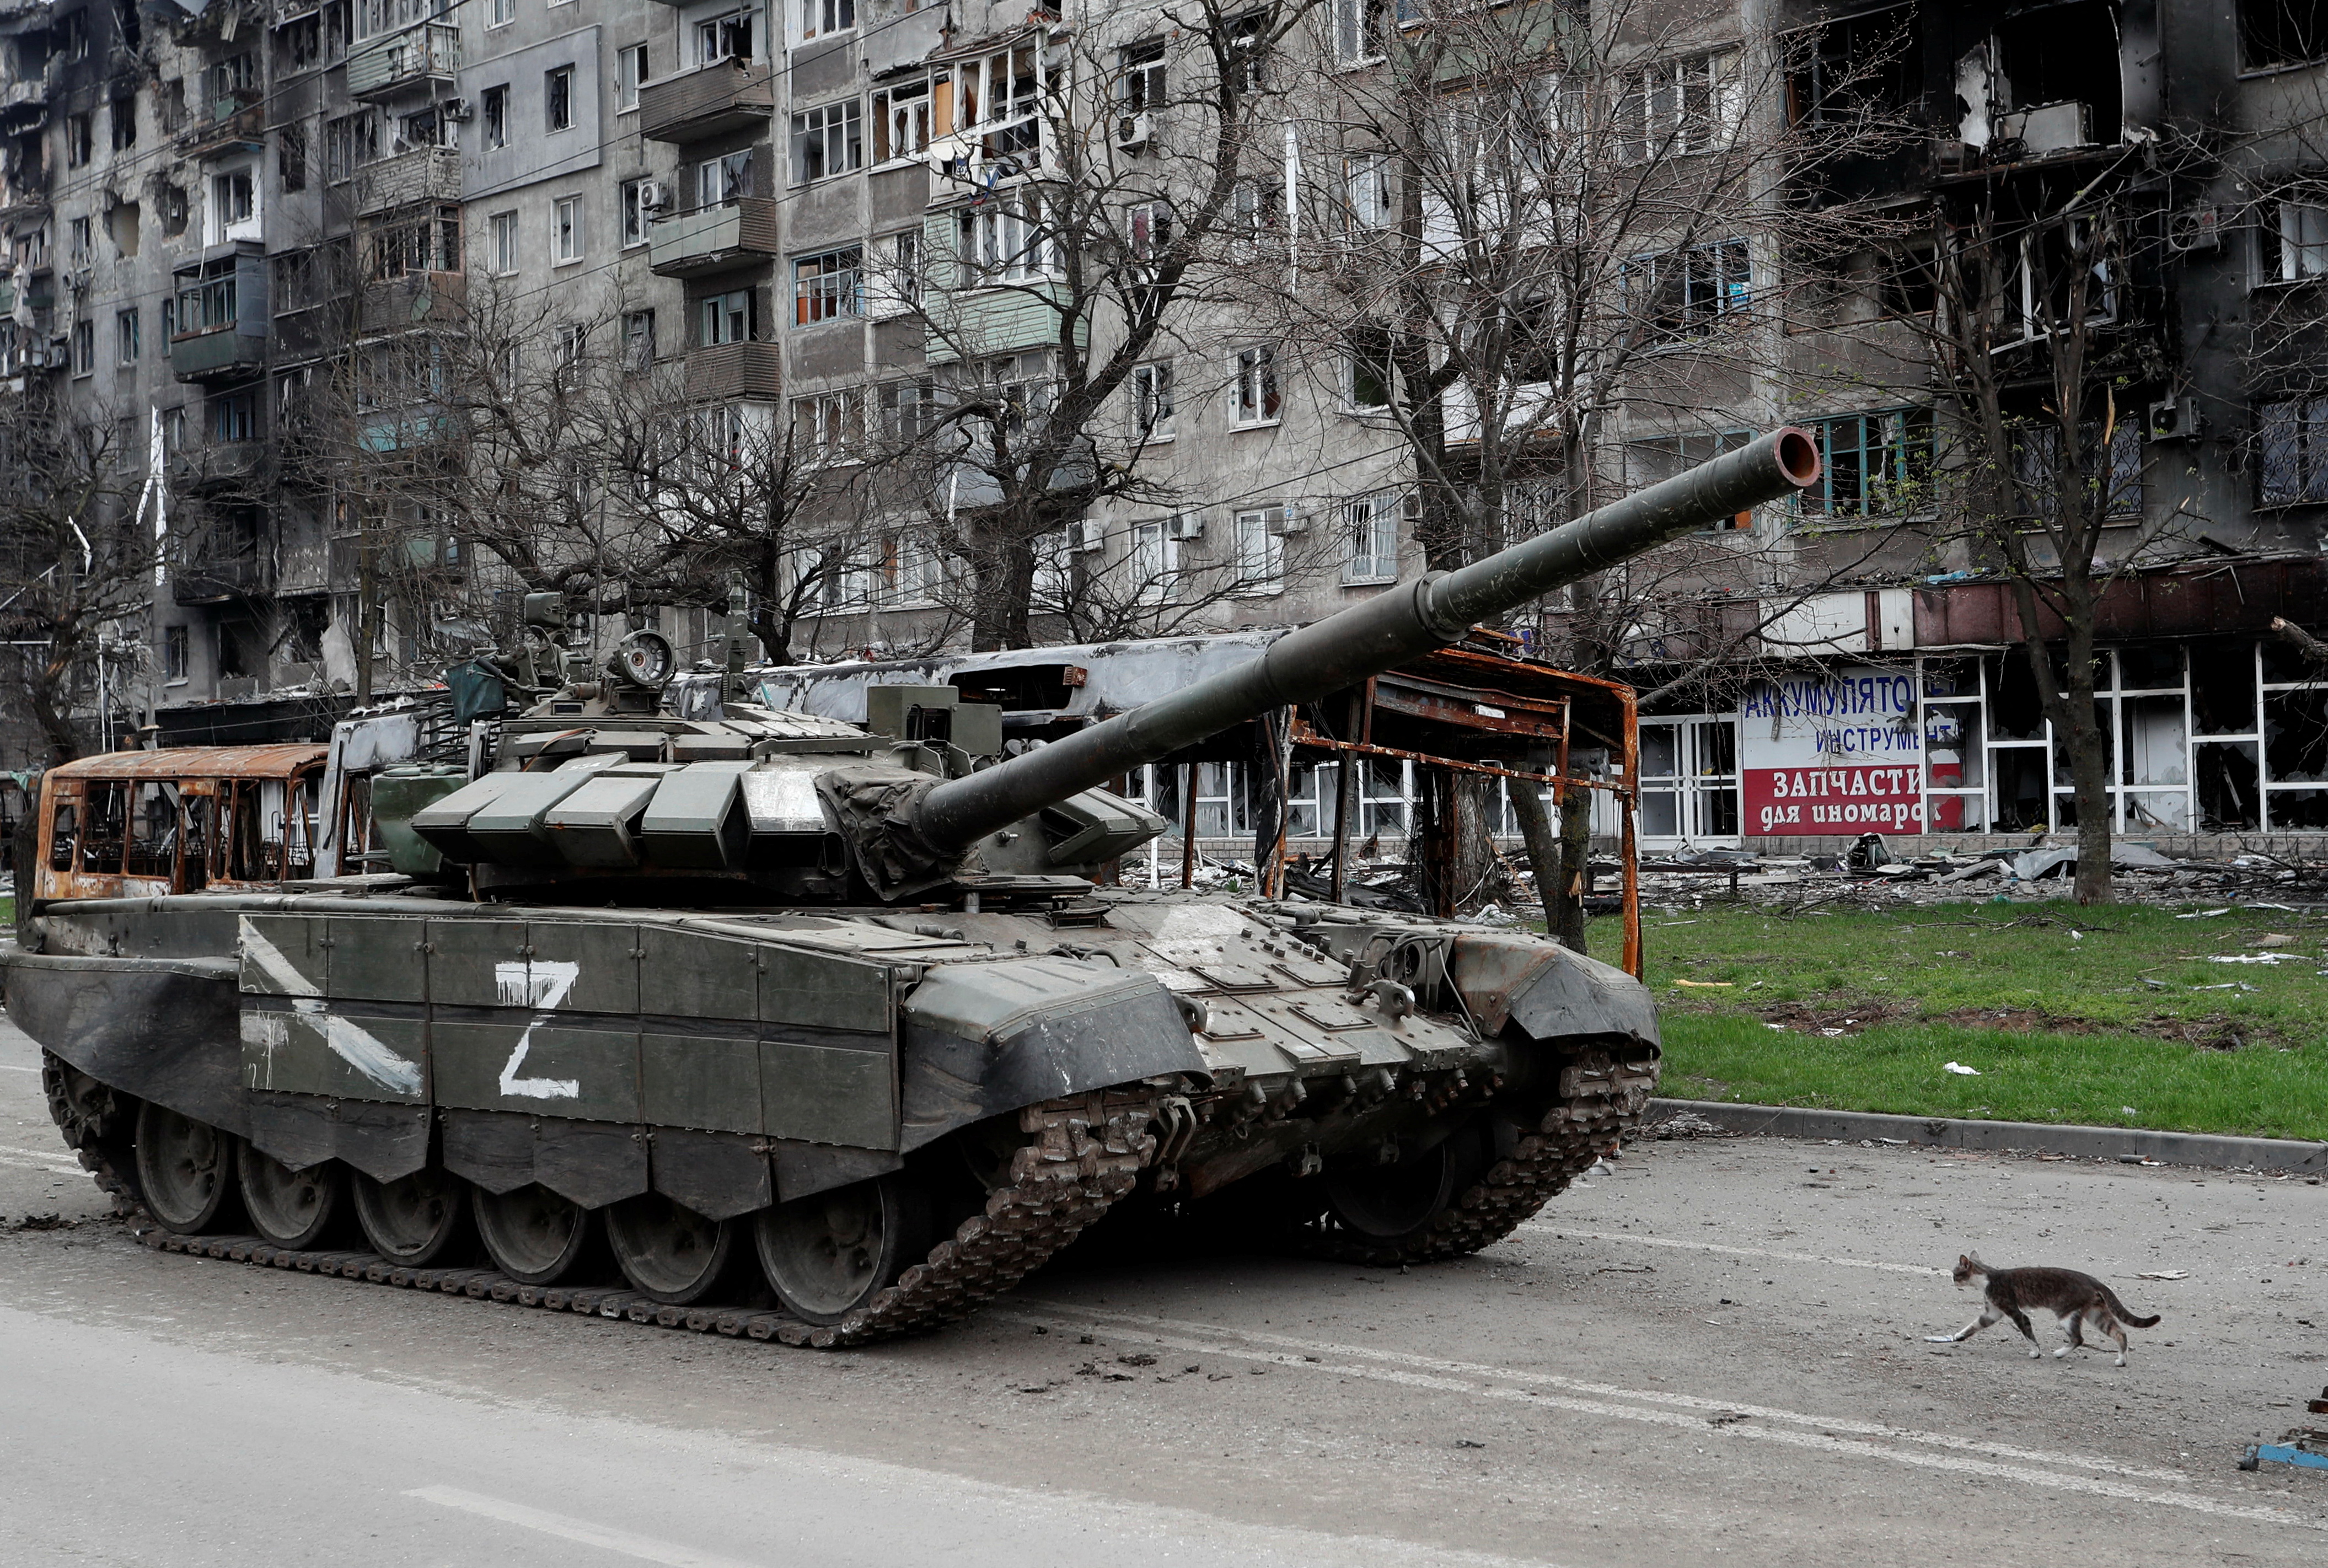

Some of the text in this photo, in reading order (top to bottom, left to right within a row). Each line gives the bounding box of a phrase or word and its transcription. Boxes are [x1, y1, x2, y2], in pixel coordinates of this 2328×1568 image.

[1773, 769, 1921, 798] ЗАПЧАСТИ
[1761, 805, 1801, 831] для
[495, 959, 580, 1099] Z
